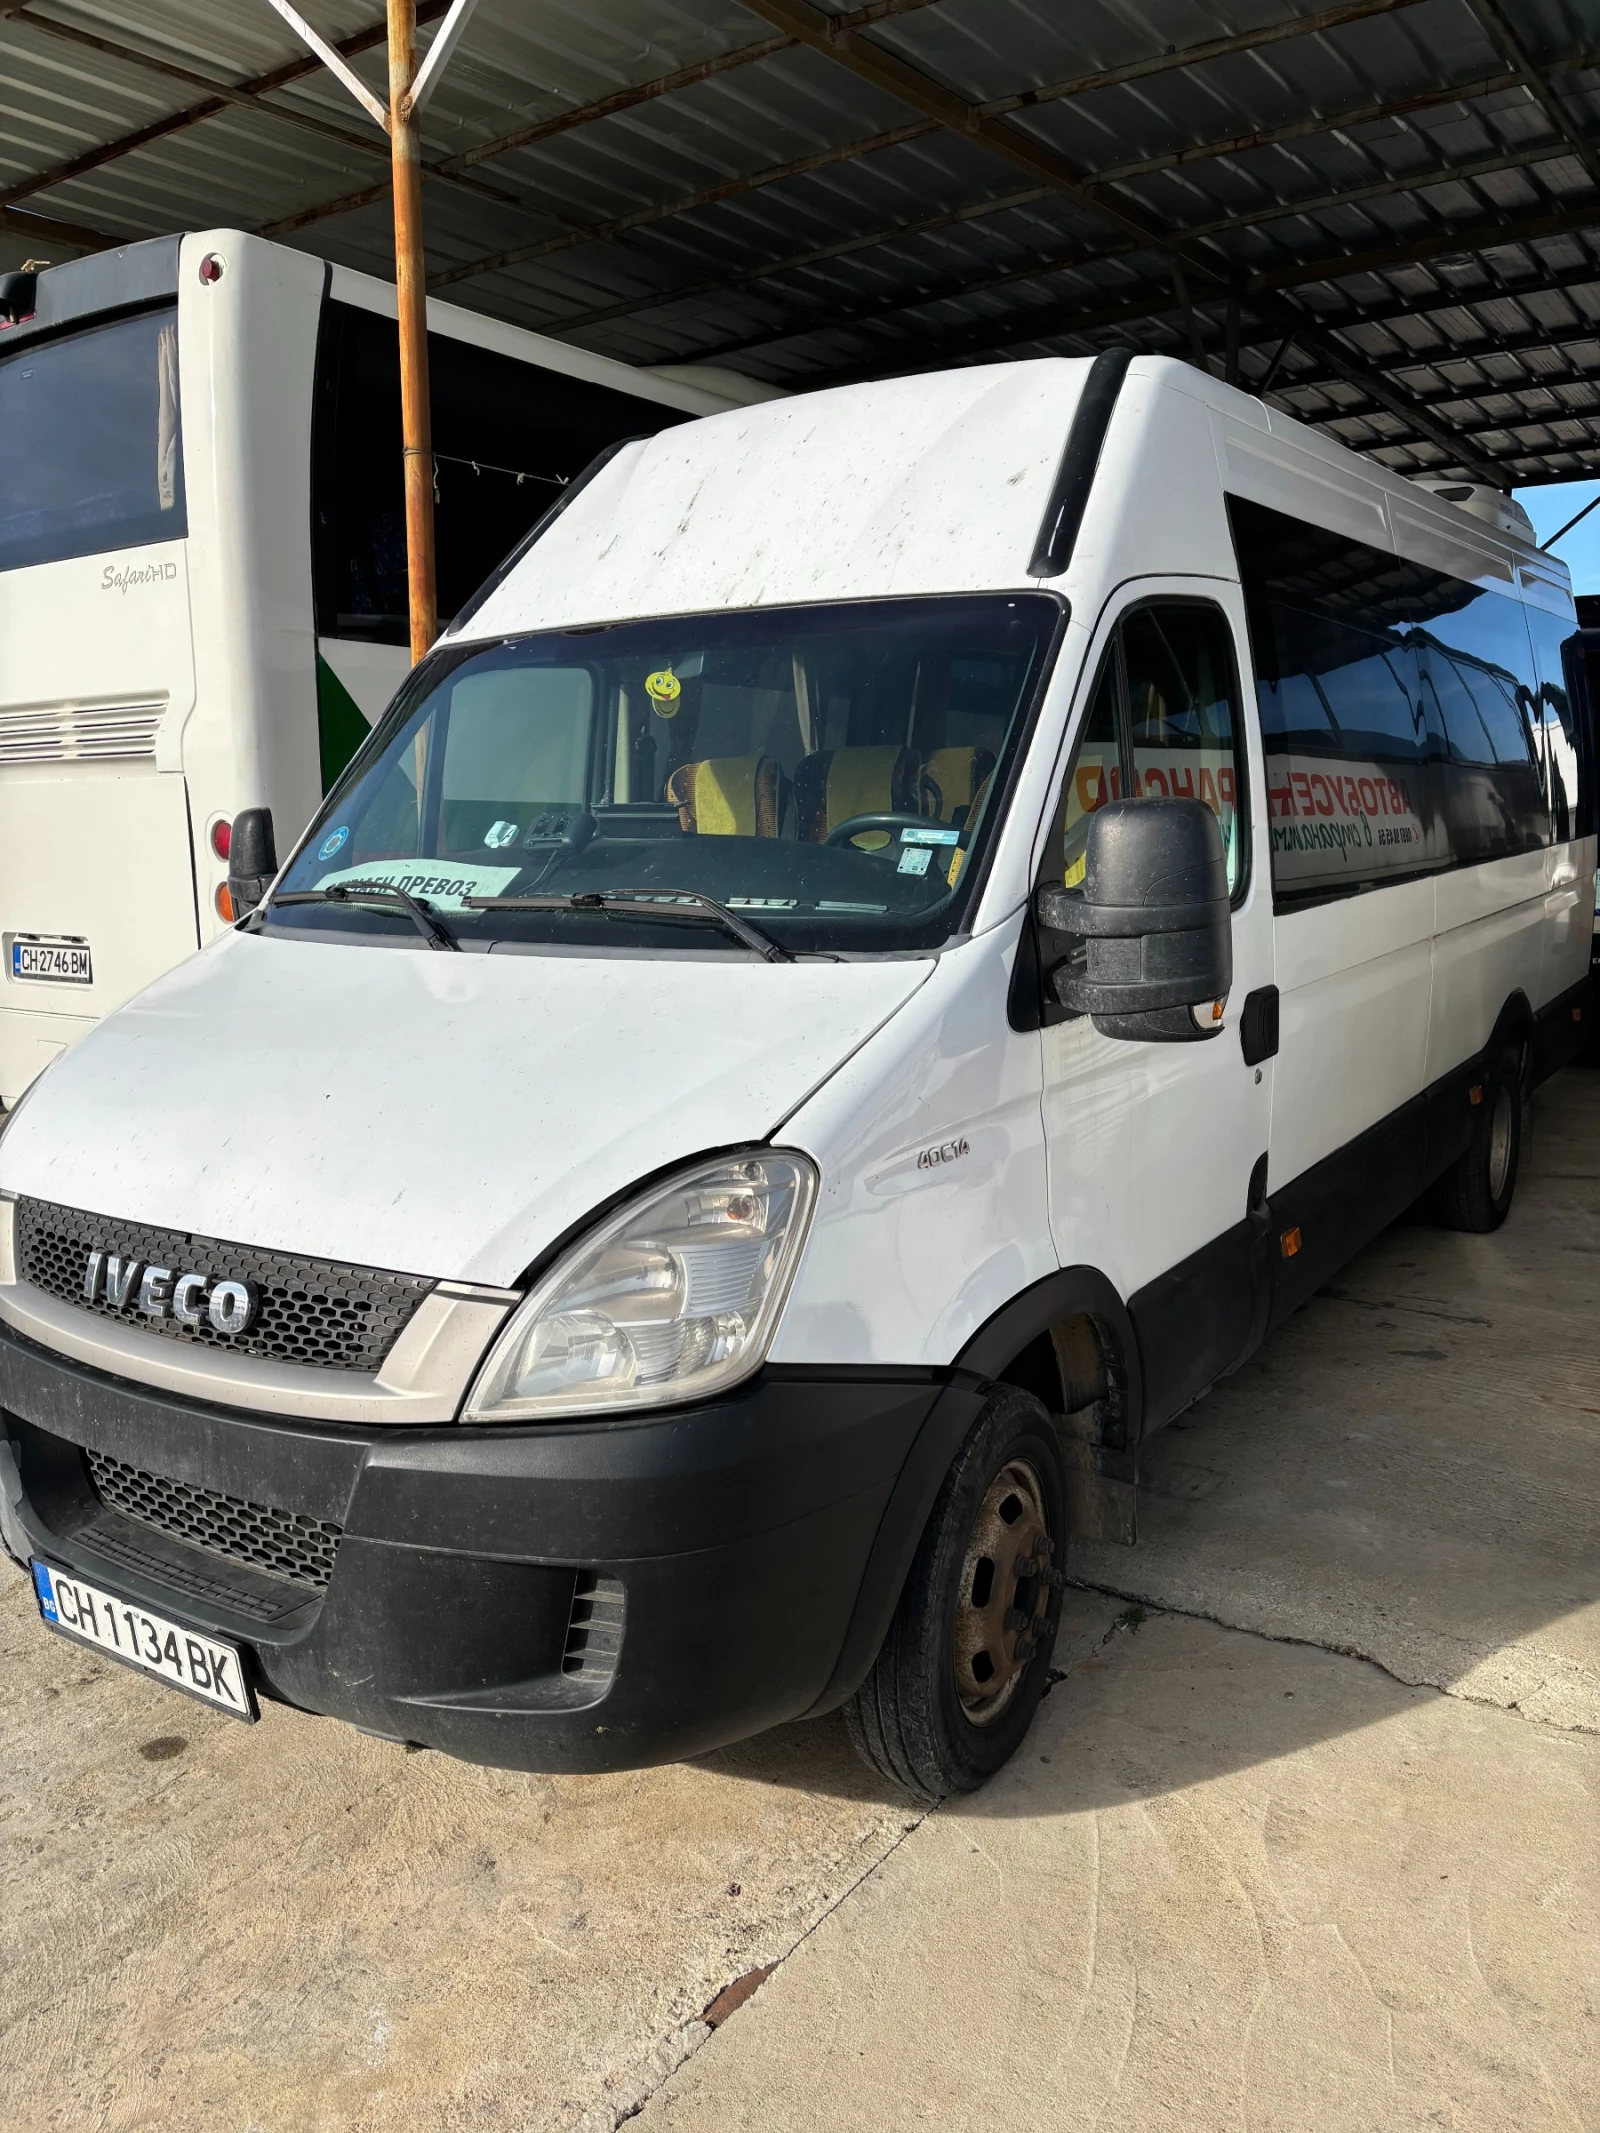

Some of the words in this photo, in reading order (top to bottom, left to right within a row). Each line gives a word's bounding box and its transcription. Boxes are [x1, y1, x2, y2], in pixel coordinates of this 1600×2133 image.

[398, 875, 478, 898] ПРЕВОЗ
[917, 1137, 971, 1170] 40C14
[83, 1250, 255, 1335] IVECO
[42, 1596, 57, 1613] BG
